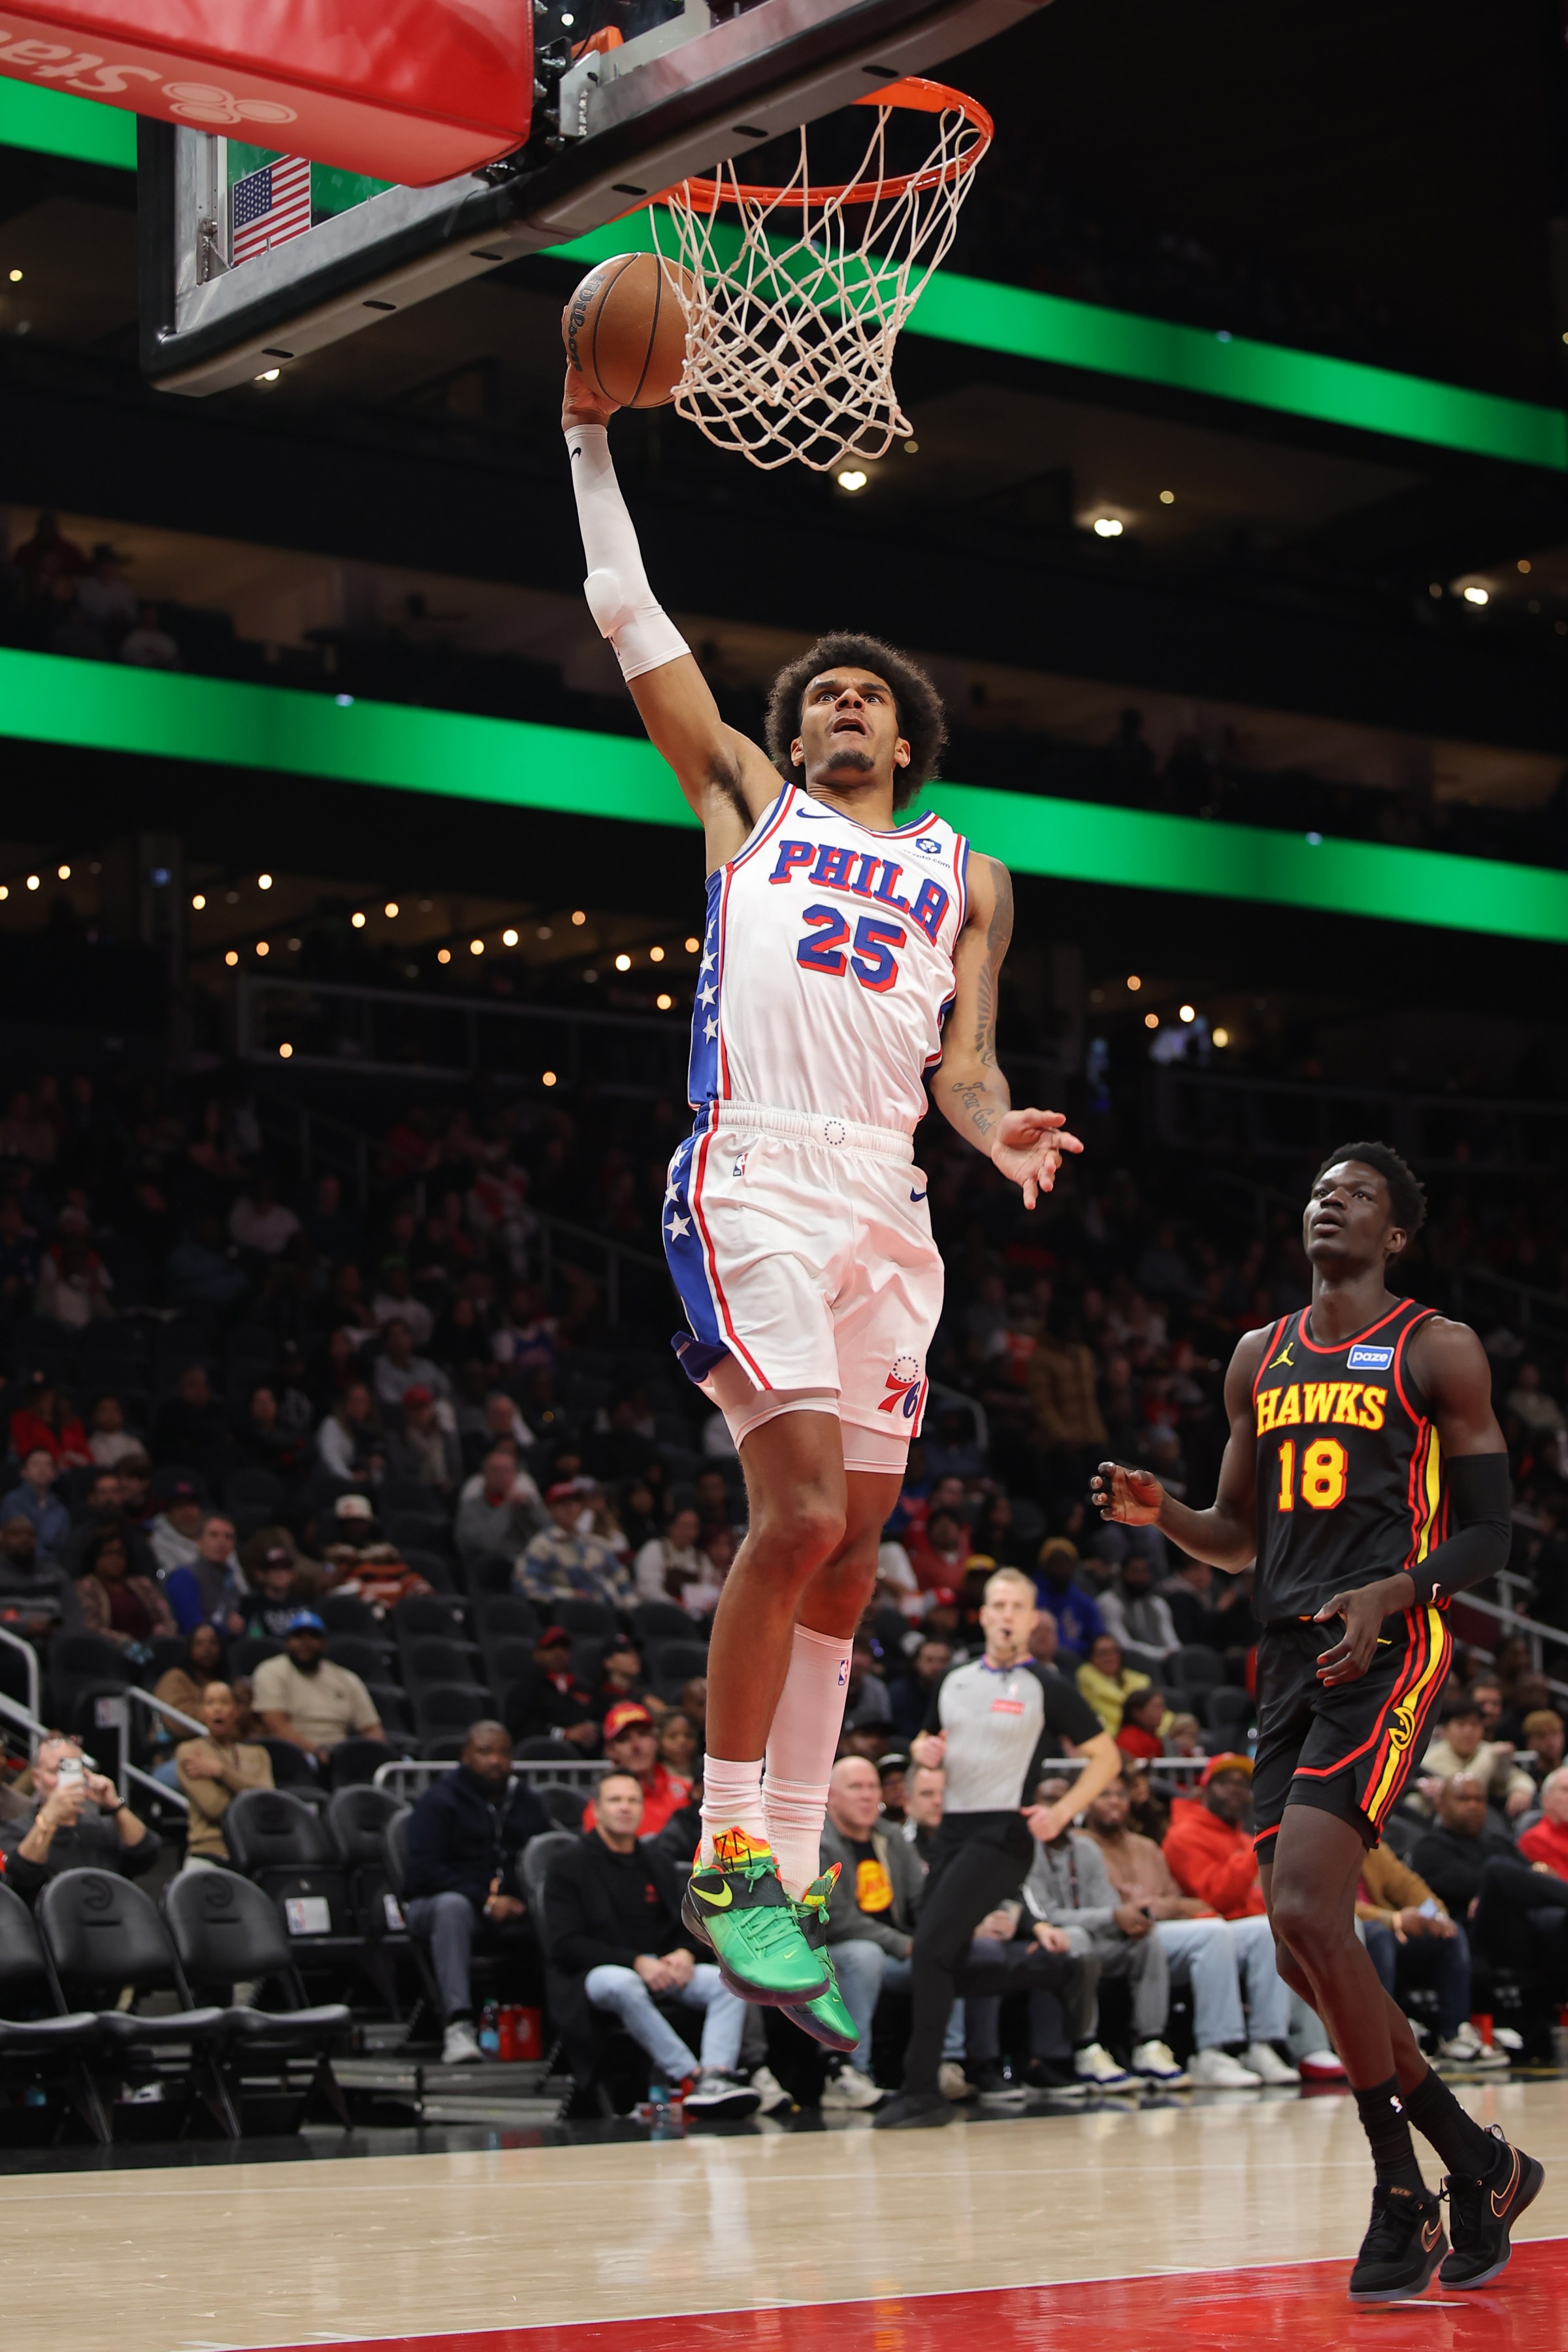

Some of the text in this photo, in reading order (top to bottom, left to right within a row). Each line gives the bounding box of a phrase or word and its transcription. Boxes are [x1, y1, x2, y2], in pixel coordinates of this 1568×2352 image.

[0, 30, 163, 93] Sta
[769, 840, 950, 947] PHILA
[796, 904, 907, 993] 25
[1352, 1352, 1389, 1364] paze
[877, 1371, 921, 1419] 76
[1256, 1381, 1388, 1438] HAWKS
[1277, 1437, 1348, 1512] 18
